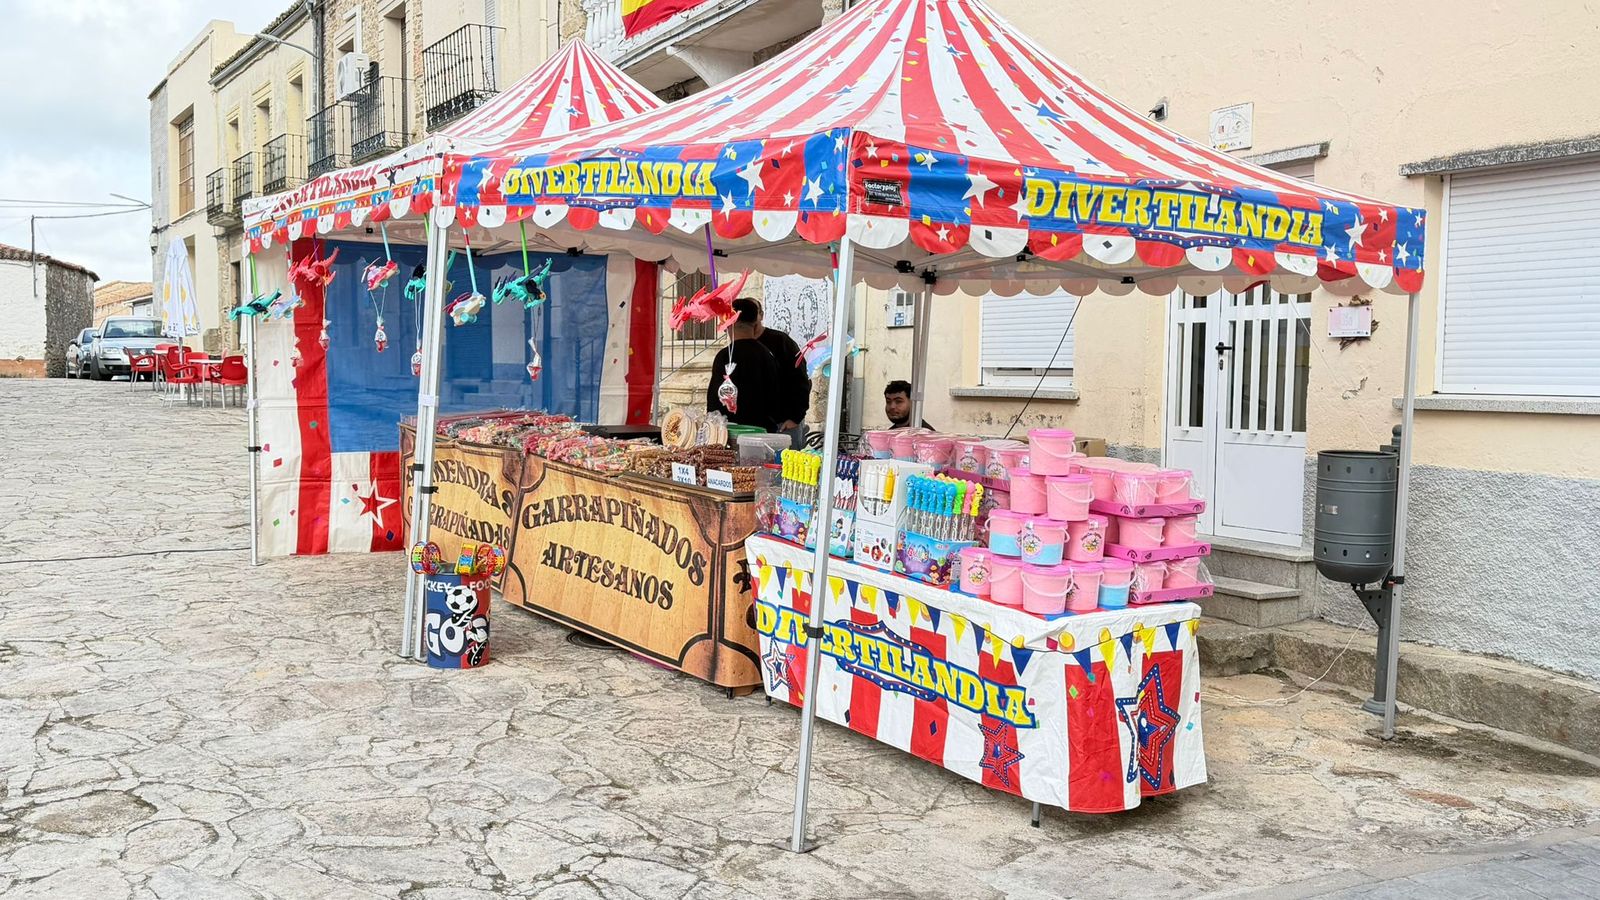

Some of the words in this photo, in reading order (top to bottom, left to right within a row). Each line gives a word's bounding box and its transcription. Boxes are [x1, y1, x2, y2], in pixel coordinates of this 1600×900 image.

[503, 159, 719, 197] DIVERTILANDIA
[1024, 178, 1325, 247] DIVERTILANDIA
[406, 459, 515, 519] AMENDRAS
[408, 496, 511, 550] GRRAPIÑADAS
[521, 493, 707, 586] GARRAPIÑADOS
[541, 541, 674, 610] ARTESANOS
